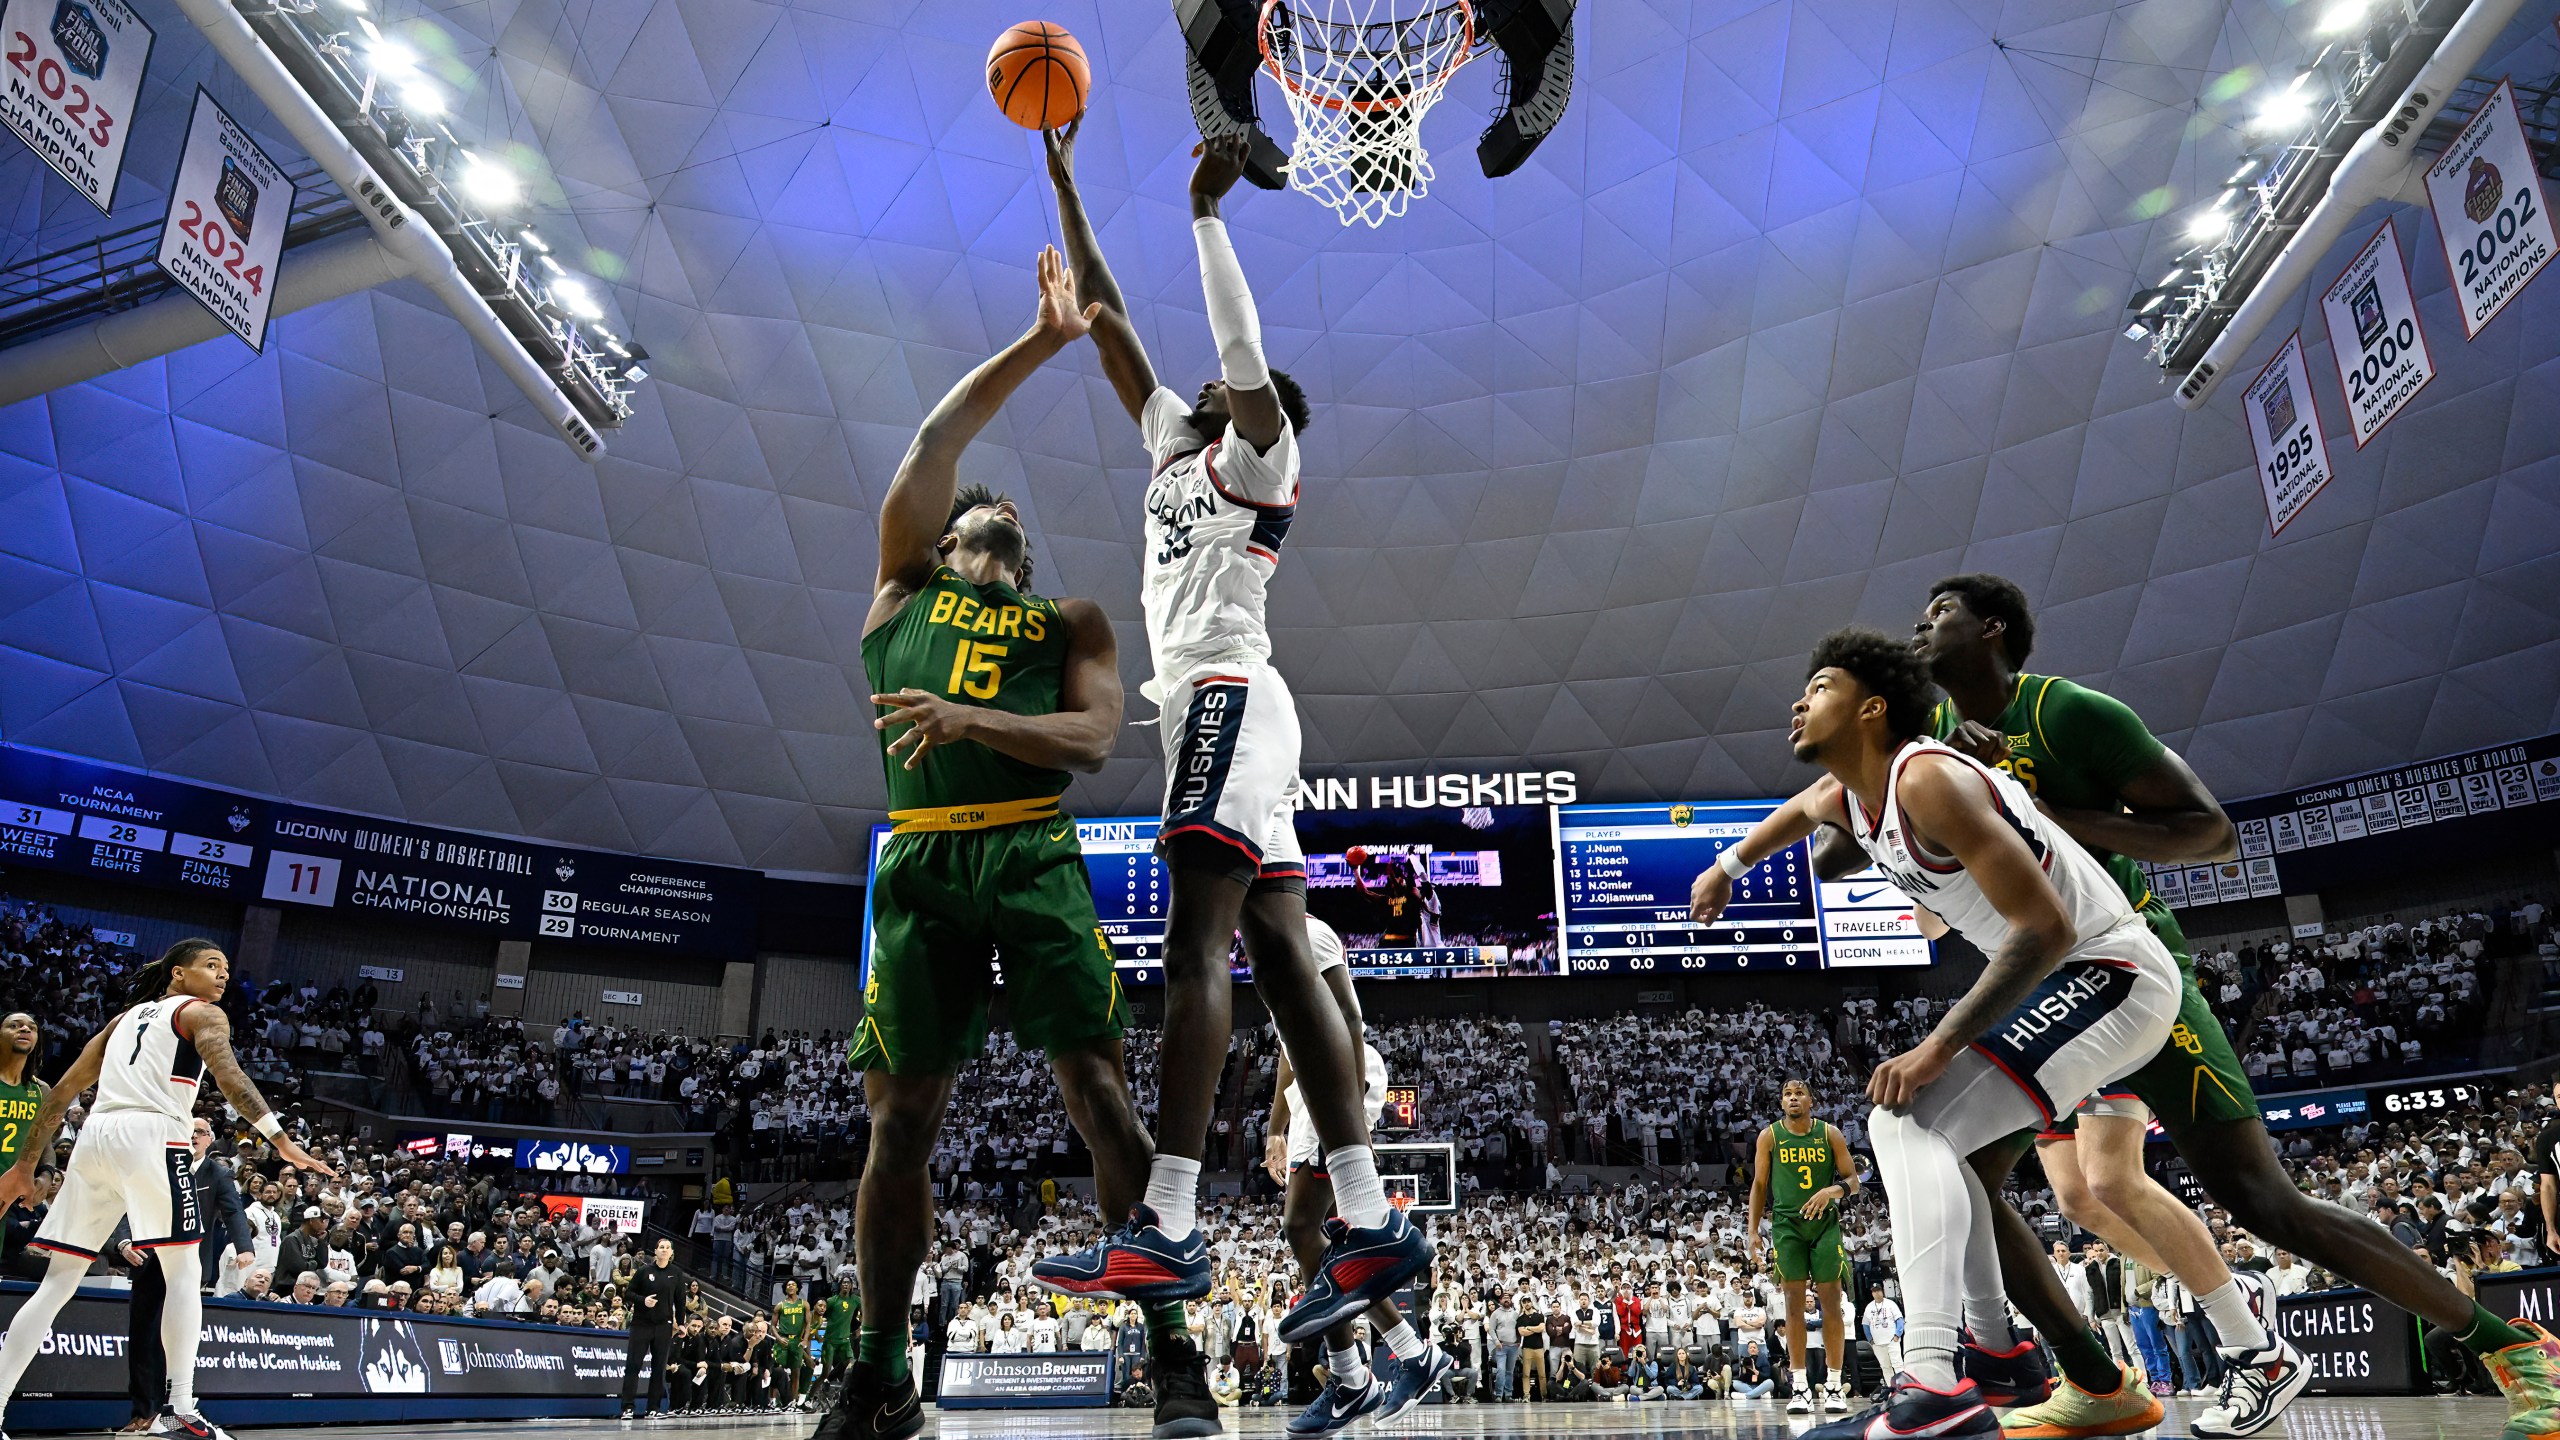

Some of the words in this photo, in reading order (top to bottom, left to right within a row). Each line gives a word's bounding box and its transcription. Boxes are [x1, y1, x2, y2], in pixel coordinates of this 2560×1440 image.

[64, 29, 99, 66] FOUR
[6, 31, 114, 148] 2023
[10, 78, 96, 168] NATIONAL
[0, 94, 98, 195] CHAMPIONS
[216, 110, 250, 151] UConn
[251, 145, 278, 181] Men's
[2433, 146, 2462, 178] UConn
[2462, 93, 2502, 143] Women's
[219, 132, 270, 190] Basketball
[2449, 122, 2494, 179] Basketball
[2458, 187, 2537, 288] 2002
[178, 200, 264, 297] 2024
[2328, 272, 2352, 303] UConn
[2351, 232, 2387, 276] Women's
[2474, 232, 2536, 299] NATIONAL
[181, 241, 250, 313] NATIONAL
[2341, 257, 2380, 304] Basketball
[2475, 243, 2547, 321] CHAMPIONS
[171, 257, 252, 337] CHAMPIONS
[2348, 318, 2414, 404] 2000
[2363, 358, 2415, 414] NATIONAL
[2363, 370, 2424, 434] CHAMPIONS
[2267, 424, 2313, 489] 1995
[2276, 459, 2317, 505] NATIONAL
[2277, 470, 2324, 523] CHAMPIONS
[928, 590, 1047, 642] BEARS
[947, 639, 1008, 700] 15
[1180, 691, 1228, 814] HUSKIES
[2296, 787, 2342, 805] UCONN
[2346, 772, 2402, 798] WOMEN'S
[2406, 760, 2460, 785] HUSKIES
[2464, 756, 2479, 772] OF
[2483, 747, 2528, 769] HONOR
[2468, 775, 2489, 792] 31
[2499, 767, 2528, 785] 23
[92, 786, 135, 803] NCAA
[1371, 771, 1577, 809] HUSKIES
[2397, 788, 2425, 806] 20
[17, 807, 42, 826] 31
[59, 793, 163, 822] TOURNAMENT
[950, 812, 968, 824] SIC
[970, 811, 985, 822] EM
[2303, 808, 2327, 825] 52
[108, 824, 138, 843] 28
[1075, 825, 1135, 840] CONN
[2242, 821, 2266, 836] 42
[2279, 816, 2291, 831] 3
[0, 827, 59, 848] WEET
[275, 820, 347, 843] UCONN
[354, 829, 430, 860] WOMEN'S
[435, 842, 532, 876] BASKETBALL
[93, 844, 144, 863] ELITE
[198, 841, 226, 859] 23
[1570, 845, 1577, 854] 2
[1586, 844, 1622, 854] J.Nunn
[91, 857, 141, 873] EIGHTS
[183, 860, 232, 878] FINAL
[1571, 857, 1578, 866] 3
[1586, 856, 1628, 866] J.Roach
[181, 872, 230, 889] FOURS
[288, 863, 321, 895] 11
[630, 873, 706, 889] CONFERENCE
[1570, 869, 1581, 878] 13
[1587, 868, 1623, 878] L.Love
[355, 869, 511, 909] NATIONAL
[619, 884, 713, 901] CHAMPIONSHIPS
[1570, 882, 1582, 891] 15
[1588, 881, 1632, 890] N.Omier
[351, 891, 511, 925] CHAMPIONSHIPS
[1571, 895, 1582, 903] 17
[1589, 892, 1654, 903] J.Ojianwuna
[548, 896, 573, 909] 30
[582, 900, 650, 917] REGULAR
[654, 908, 711, 923] SEASON
[1655, 911, 1687, 921] TEAM
[545, 919, 569, 933] 29
[579, 924, 681, 944] TOURNAMENT
[1101, 924, 1129, 934] TATS
[1834, 921, 1901, 933] TRAVELERS
[2298, 926, 2318, 934] EAST
[115, 934, 130, 944] 12
[1584, 934, 1594, 946] 0
[1734, 931, 1745, 942] 0
[1783, 930, 1793, 941] 0
[1136, 945, 1147, 957] 0
[1370, 952, 1413, 965] 18:34
[1446, 952, 1455, 963] 2
[1834, 948, 1881, 958] UCONN
[1572, 958, 1609, 971] 100.0
[1630, 957, 1654, 970] 0.0
[1681, 956, 1706, 968] 0.0
[1737, 955, 1748, 967] 0
[1786, 954, 1796, 966] 0
[386, 969, 399, 979] 13
[1137, 969, 1148, 981] 0
[626, 994, 639, 1003] 14
[129, 1023, 149, 1066] 1
[0, 1099, 37, 1120] EARS
[2385, 1089, 2446, 1112] 6:33
[1399, 1104, 1411, 1125] 9
[2, 1122, 18, 1153] 2
[1779, 1147, 1826, 1163] BEARS
[1798, 1165, 1812, 1190] 3
[174, 1153, 196, 1232] HUSKIES
[784, 1307, 803, 1315] BEARS
[2275, 1303, 2374, 1338] ICHAELS
[216, 1325, 260, 1345] Wealth
[260, 1328, 335, 1351] Management
[223, 1352, 236, 1369] of
[237, 1354, 258, 1370] the
[259, 1353, 298, 1370] UConn
[300, 1354, 342, 1371] Huskies
[572, 1346, 594, 1359] Official
[594, 1347, 616, 1360] Wealth
[574, 1364, 599, 1380] Sponsor
[606, 1366, 617, 1378] the
[2310, 1350, 2370, 1379] ELERS
